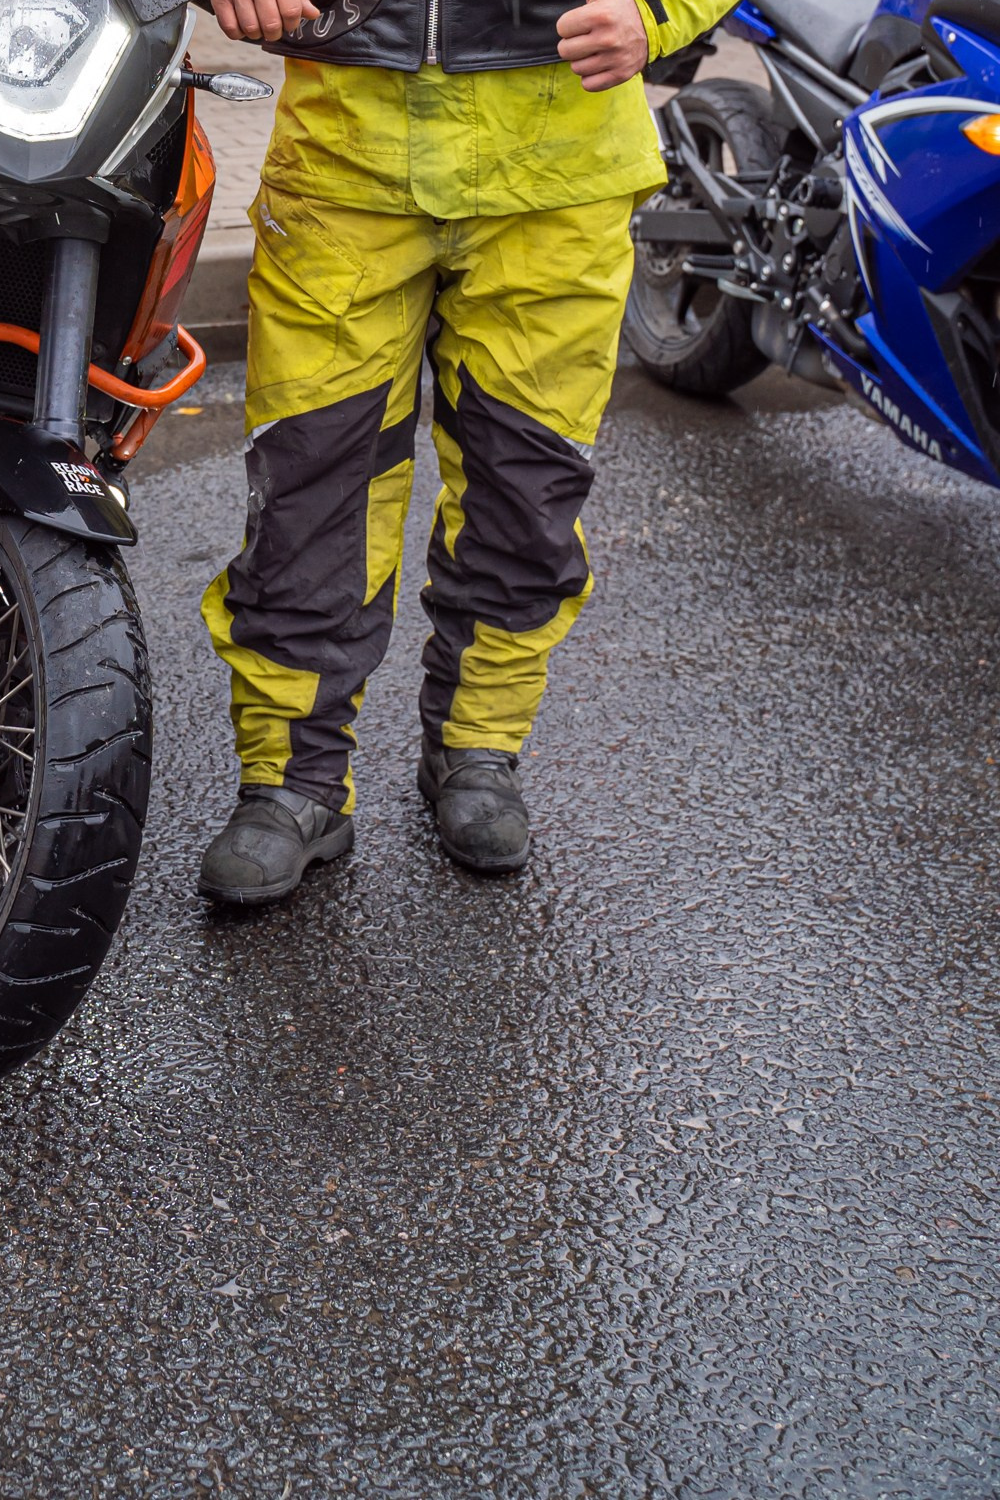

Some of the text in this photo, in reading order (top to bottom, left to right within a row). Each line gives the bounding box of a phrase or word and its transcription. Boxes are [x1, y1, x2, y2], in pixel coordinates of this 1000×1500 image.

[860, 371, 943, 462] YAMAHA
[50, 462, 98, 479] READY
[58, 471, 80, 482] TO
[63, 480, 106, 497] RACE
